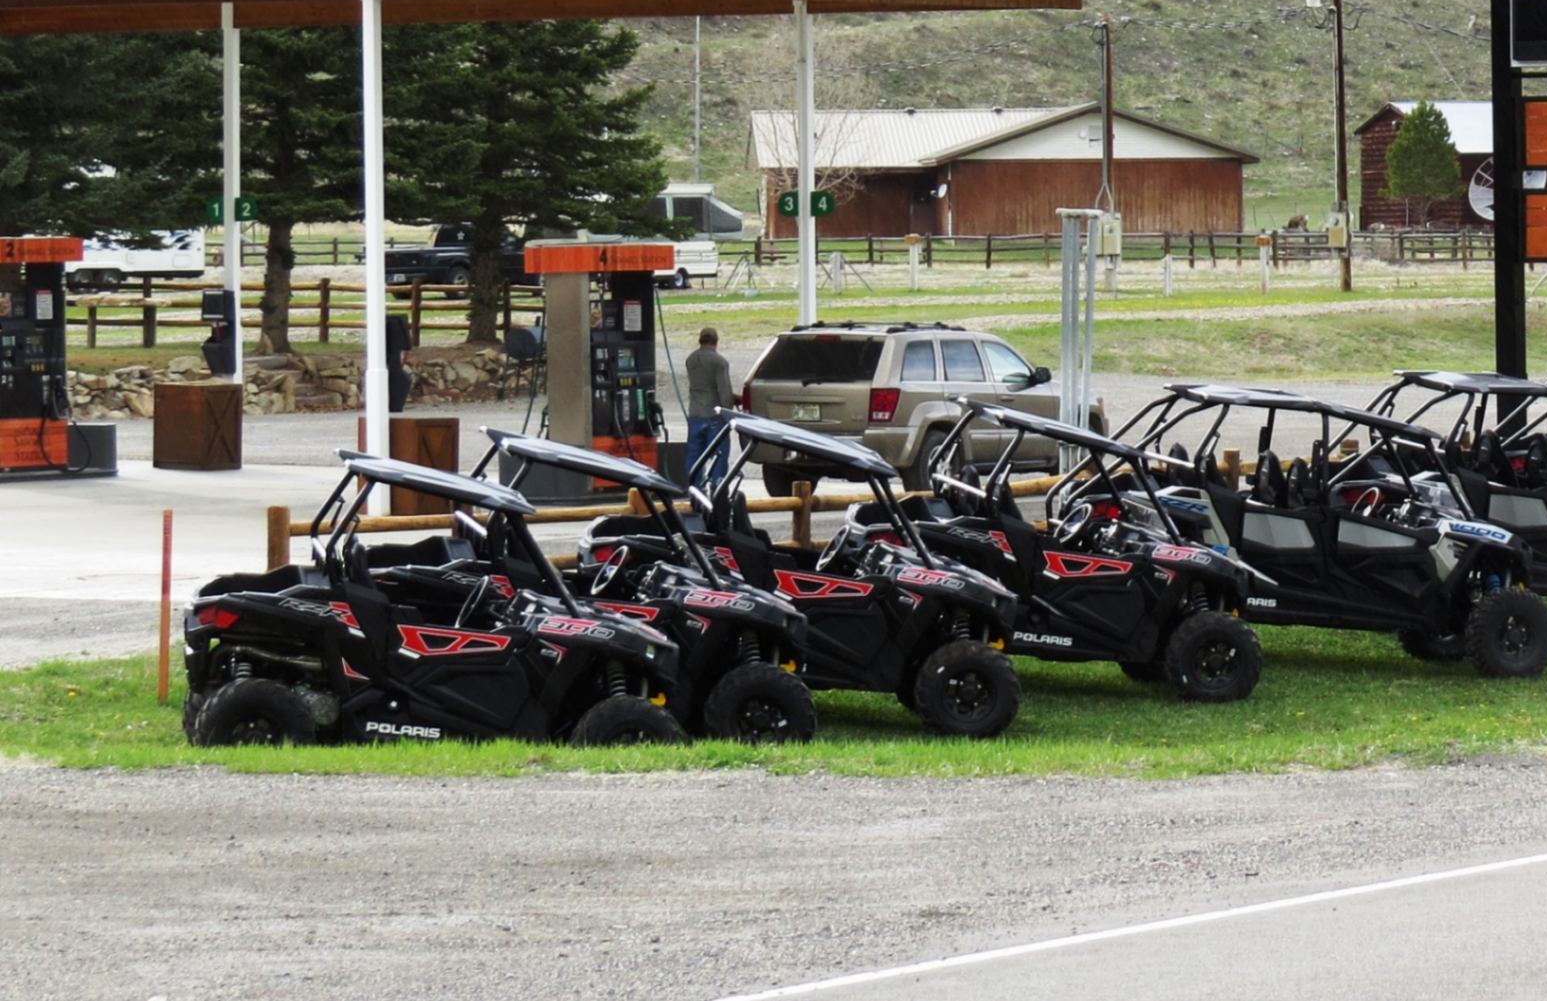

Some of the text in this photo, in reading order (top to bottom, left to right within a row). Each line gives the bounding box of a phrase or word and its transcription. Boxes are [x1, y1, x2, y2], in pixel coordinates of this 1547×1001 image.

[212, 203, 220, 217] 1
[242, 202, 251, 217] 2
[784, 196, 794, 211] 3
[817, 196, 828, 211] 4
[5, 241, 15, 258] 2
[599, 247, 608, 266] 4
[1247, 596, 1277, 608] ARIS
[1013, 631, 1073, 647] POLARIS
[366, 721, 441, 739] POLARIS
